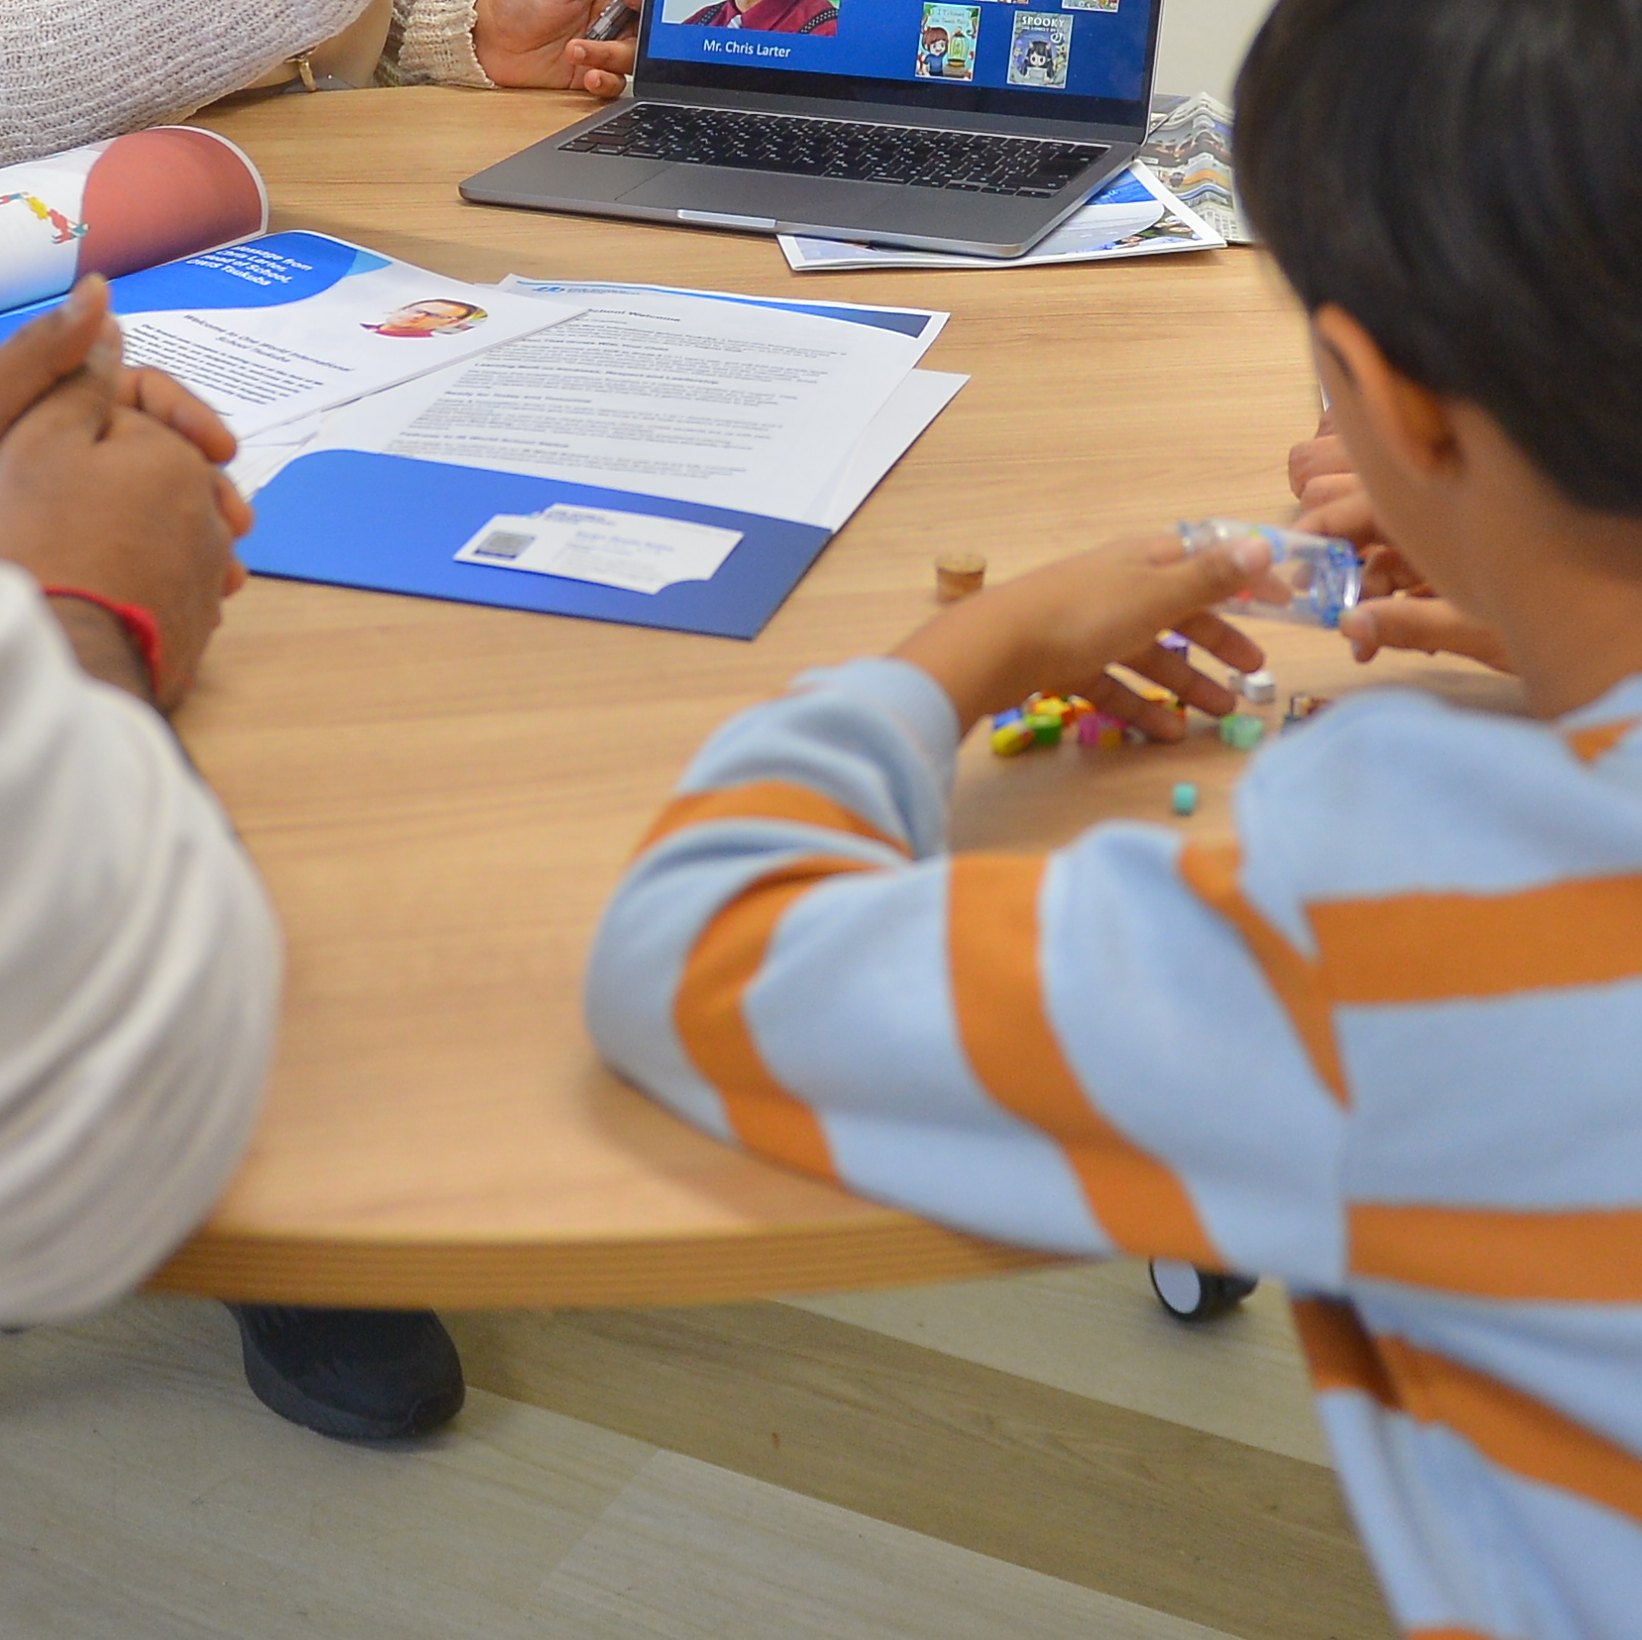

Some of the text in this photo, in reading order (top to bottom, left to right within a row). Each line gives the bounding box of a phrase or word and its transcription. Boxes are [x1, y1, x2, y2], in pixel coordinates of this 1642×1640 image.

[1022, 16, 1064, 28] SPOOKY
[703, 39, 791, 58] Mr. Chris Larter
